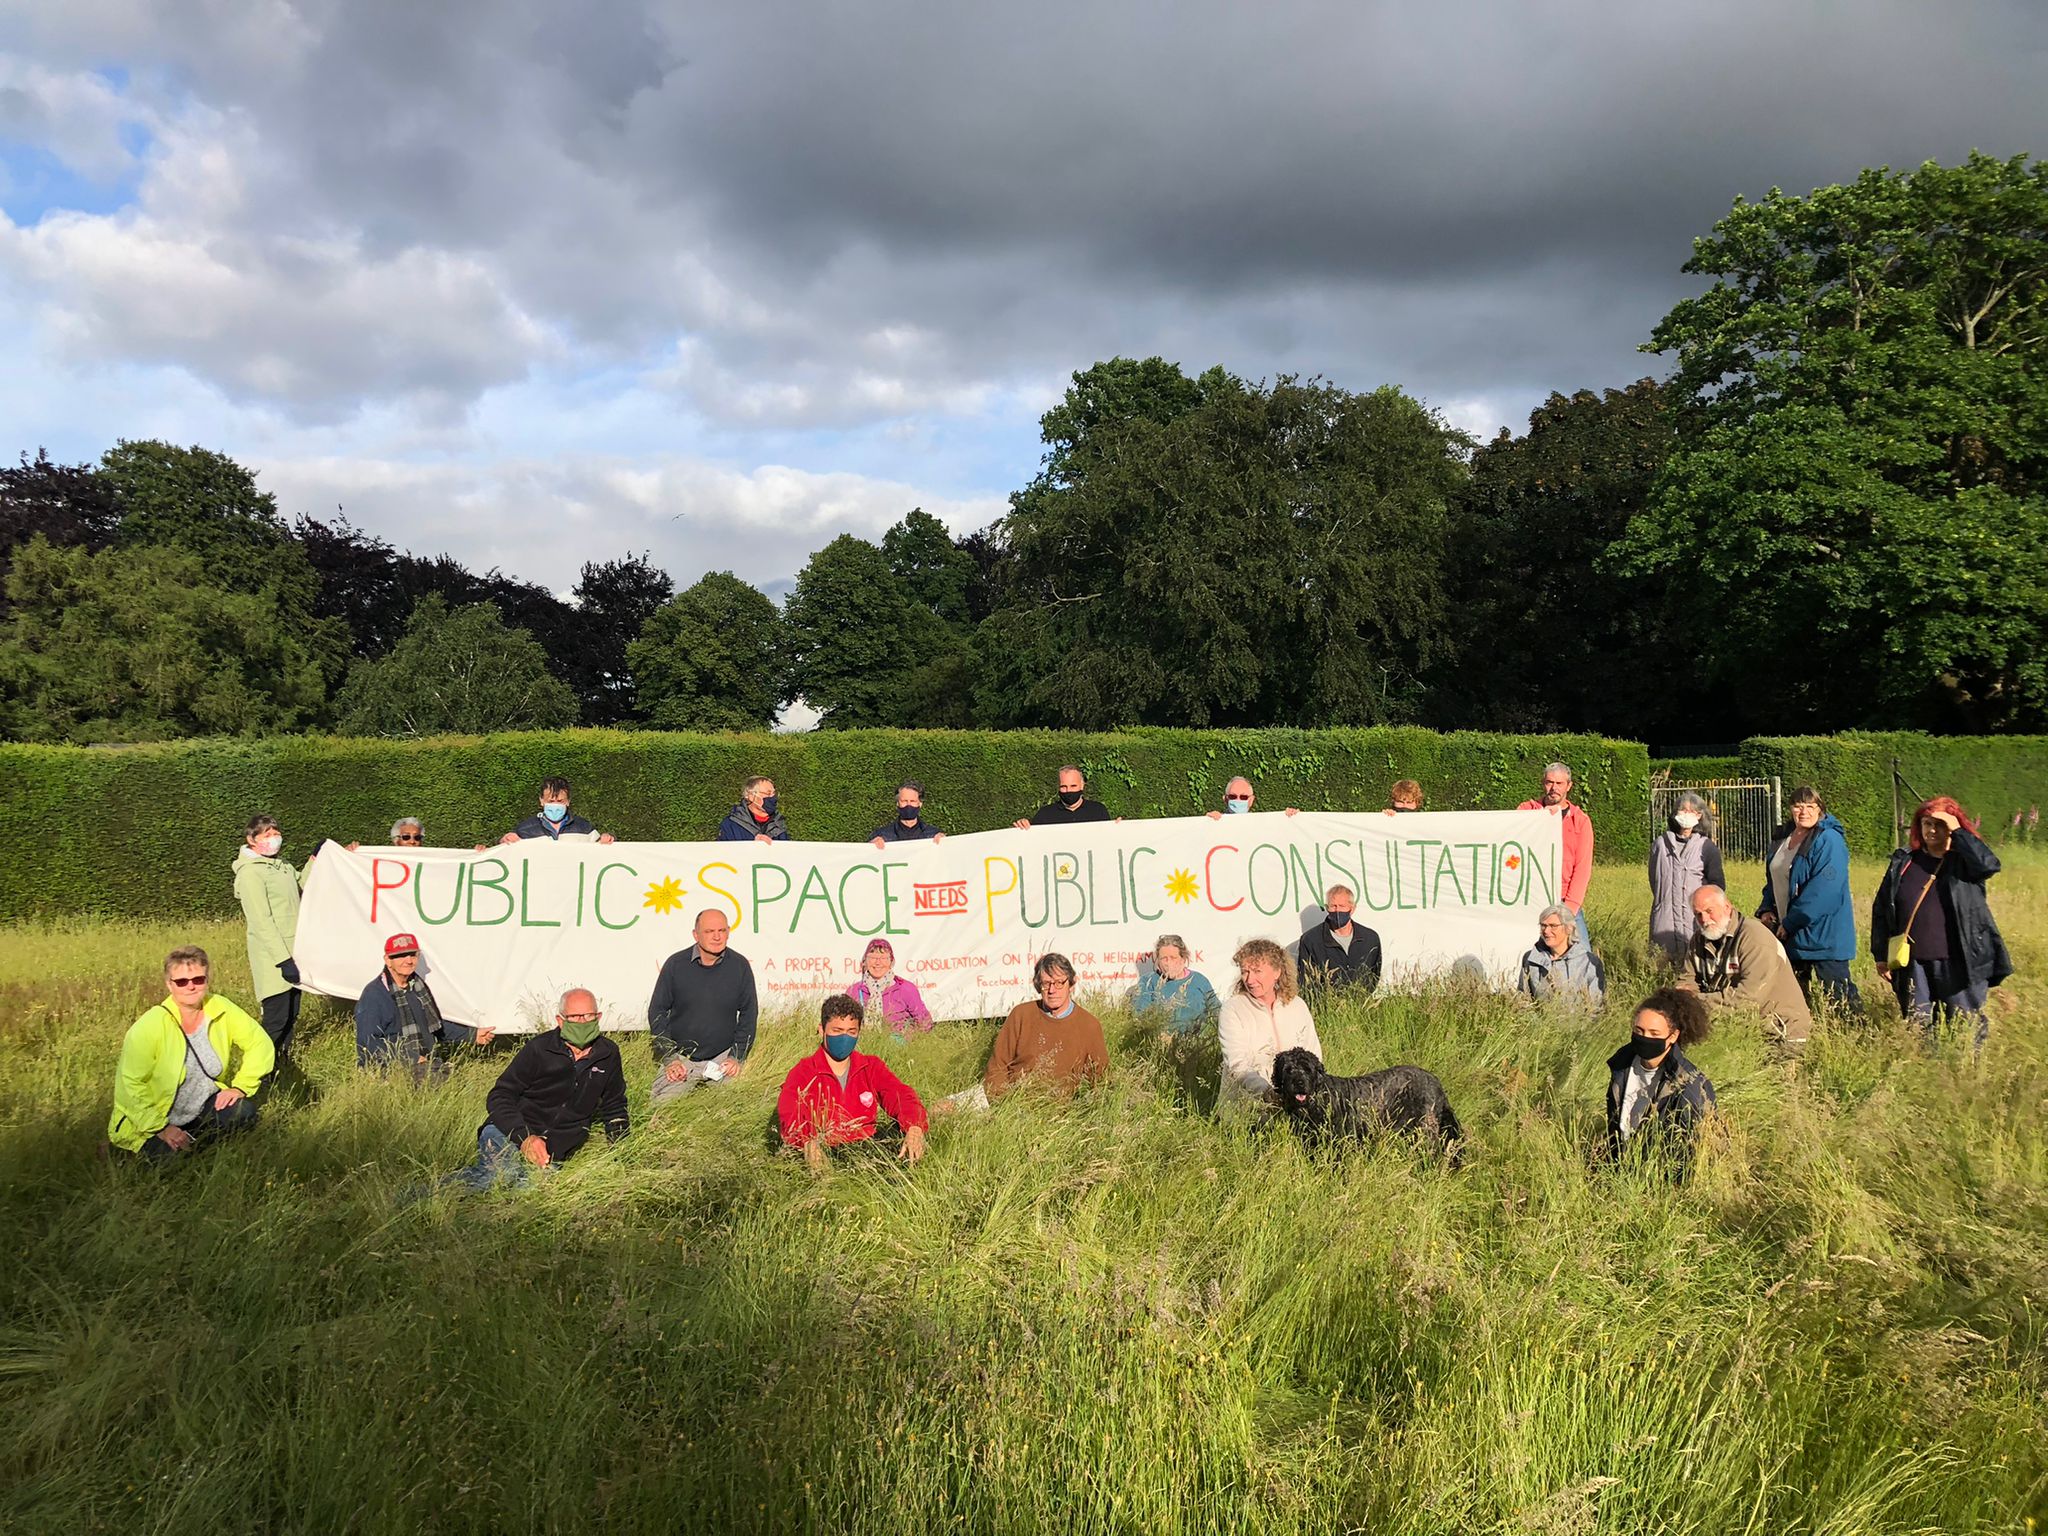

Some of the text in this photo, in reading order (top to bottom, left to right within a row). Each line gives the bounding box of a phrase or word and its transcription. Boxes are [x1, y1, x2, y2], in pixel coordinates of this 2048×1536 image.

[370, 839, 1556, 936] PUBLIC SPACE NEEDS PUBLIC CONSULTATION
[764, 957, 776, 970] A
[905, 955, 988, 973] CONSULTATION
[1002, 953, 1021, 965] ON
[1072, 952, 1096, 965] FOR
[1103, 951, 1157, 964] HEIGHAM
